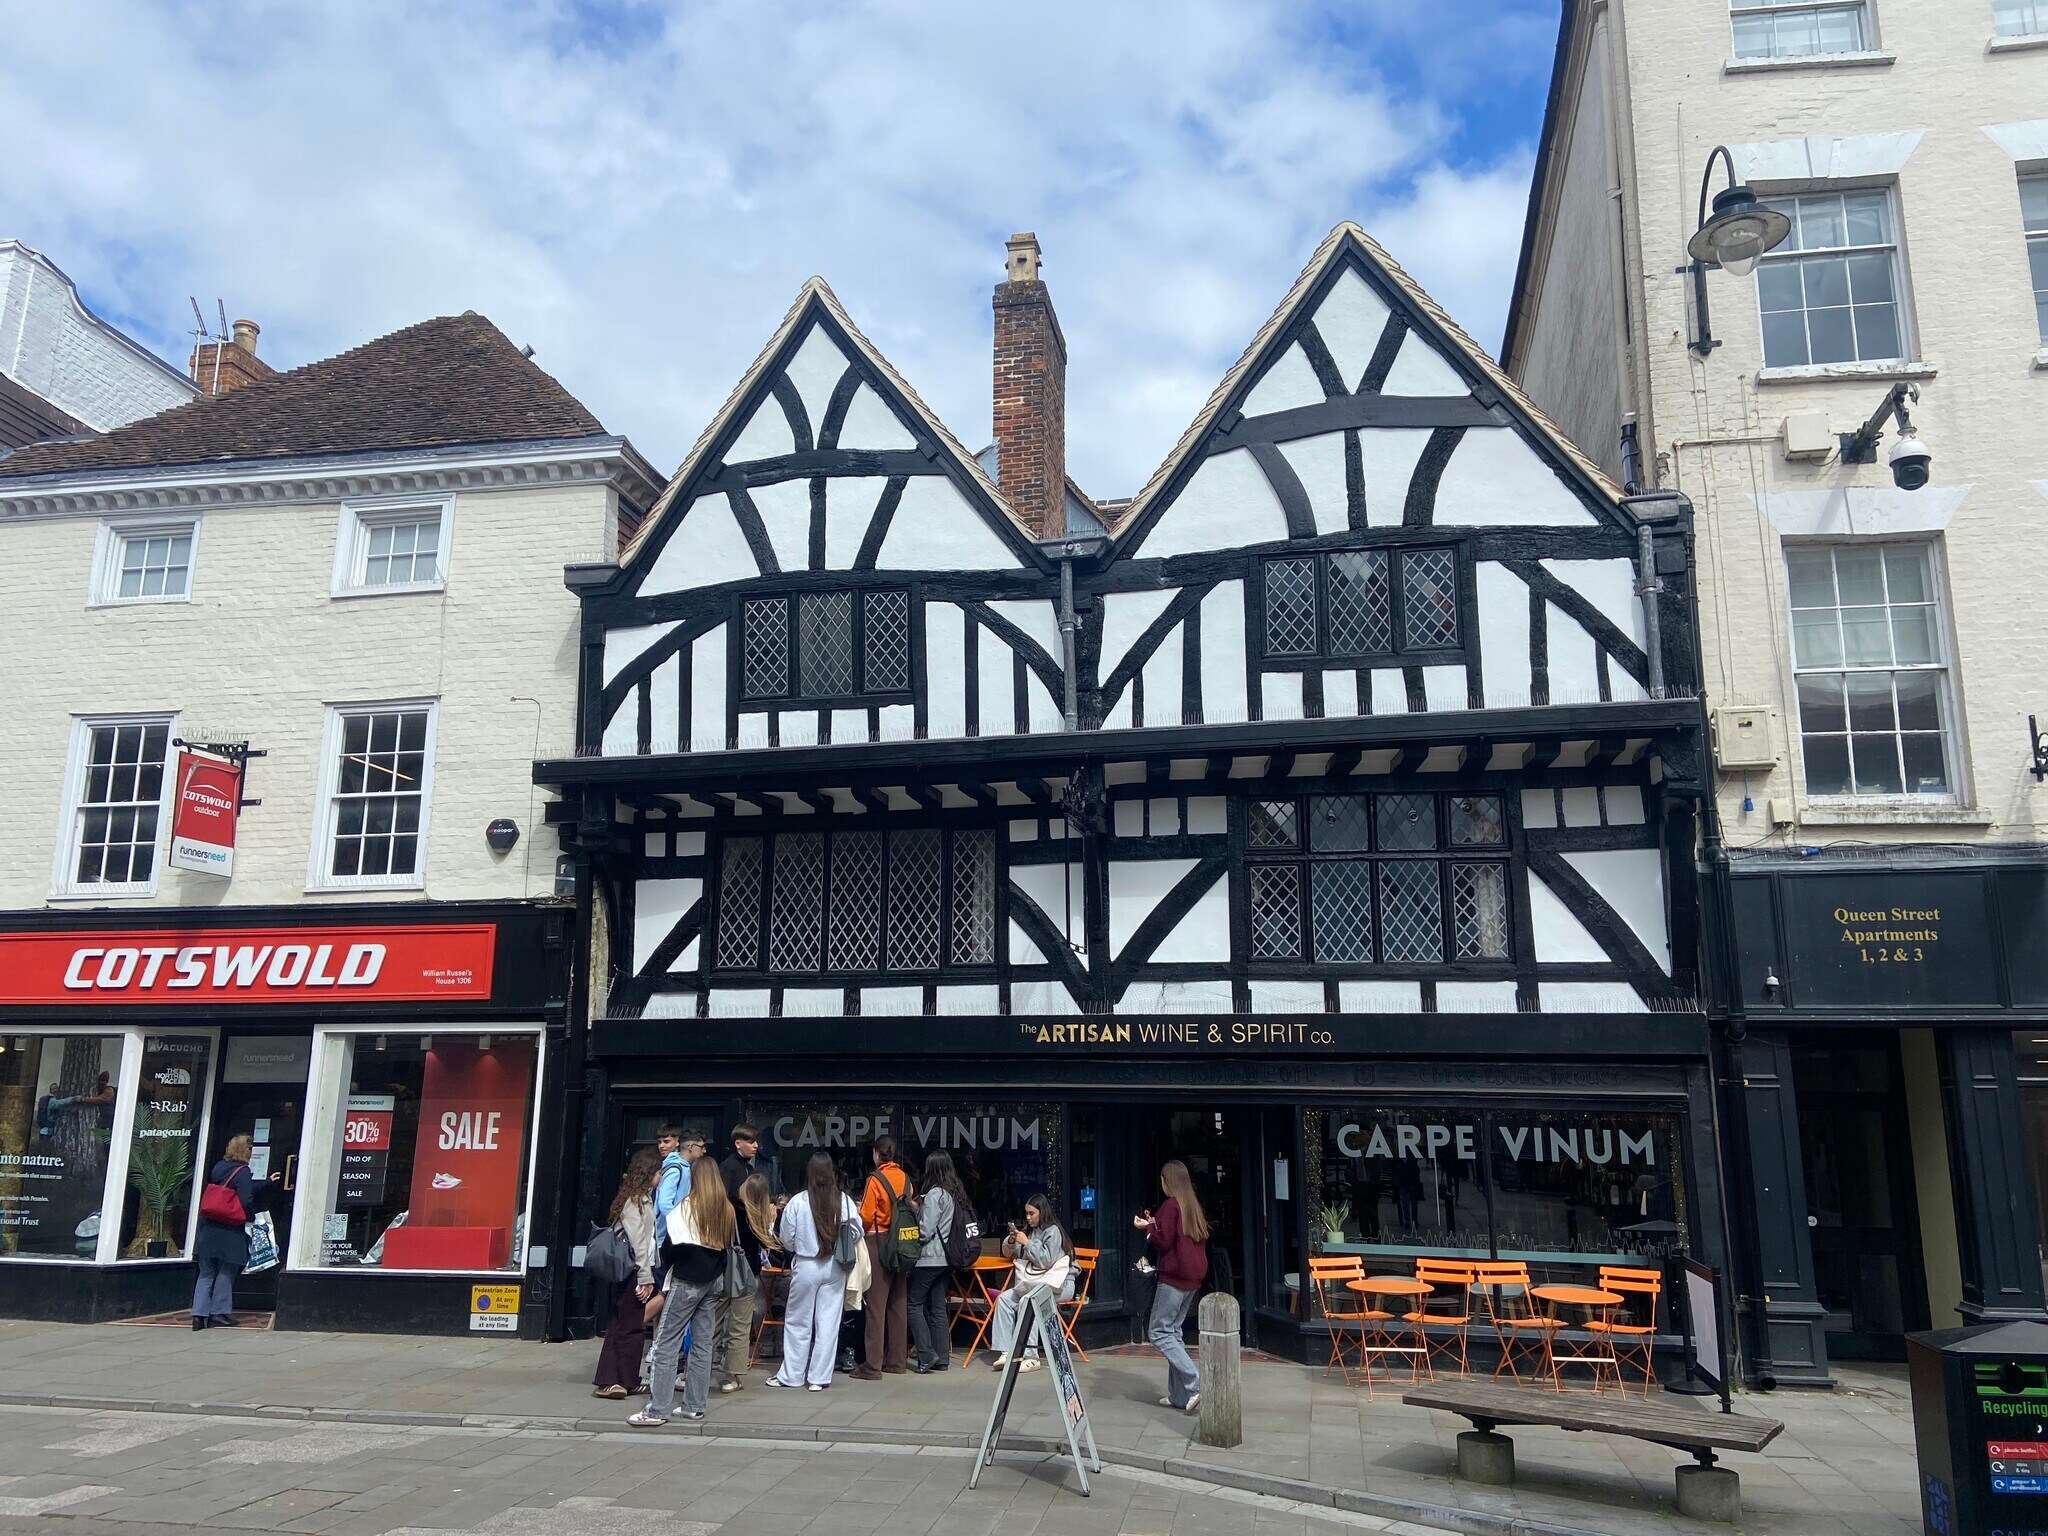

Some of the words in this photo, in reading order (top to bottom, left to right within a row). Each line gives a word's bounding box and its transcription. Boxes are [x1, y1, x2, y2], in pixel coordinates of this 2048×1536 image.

[184, 790, 232, 810] COTSWOLD
[193, 805, 220, 818] outdoor
[179, 845, 226, 863] runnersneed
[1834, 908, 1887, 925] Queen
[1891, 907, 1941, 921] Street
[1841, 928, 1939, 945] Apartments
[1860, 948, 1875, 964] 1,
[1878, 948, 1889, 962] 2
[1893, 947, 1909, 962] &
[1913, 948, 1923, 962] 3
[63, 943, 388, 990] COTSWOLD
[423, 969, 446, 977] William
[446, 969, 472, 977] Russel's
[435, 977, 456, 985] House
[1019, 1023, 1037, 1034] The
[1036, 1024, 1131, 1043] ARTISAN
[1138, 1023, 1199, 1043] WINE
[1206, 1023, 1223, 1043] &
[1231, 1023, 1308, 1043] SPIRIT
[243, 1052, 295, 1062] runnersneed
[161, 1100, 187, 1112] Rab
[139, 1128, 191, 1138] patagonia
[344, 1121, 380, 1143] 30%
[438, 1111, 501, 1150] SALE
[773, 1116, 891, 1148] CARPE
[912, 1116, 1040, 1150] VINUM
[1336, 1124, 1476, 1160] CARPE
[1499, 1126, 1655, 1166] VINUM
[0, 1151, 20, 1165] nto
[21, 1154, 64, 1167] nature.
[342, 1172, 371, 1180] SEASON
[0, 1216, 20, 1225] tional
[21, 1216, 39, 1226] Trust
[1983, 1400, 2048, 1418] Recycling
